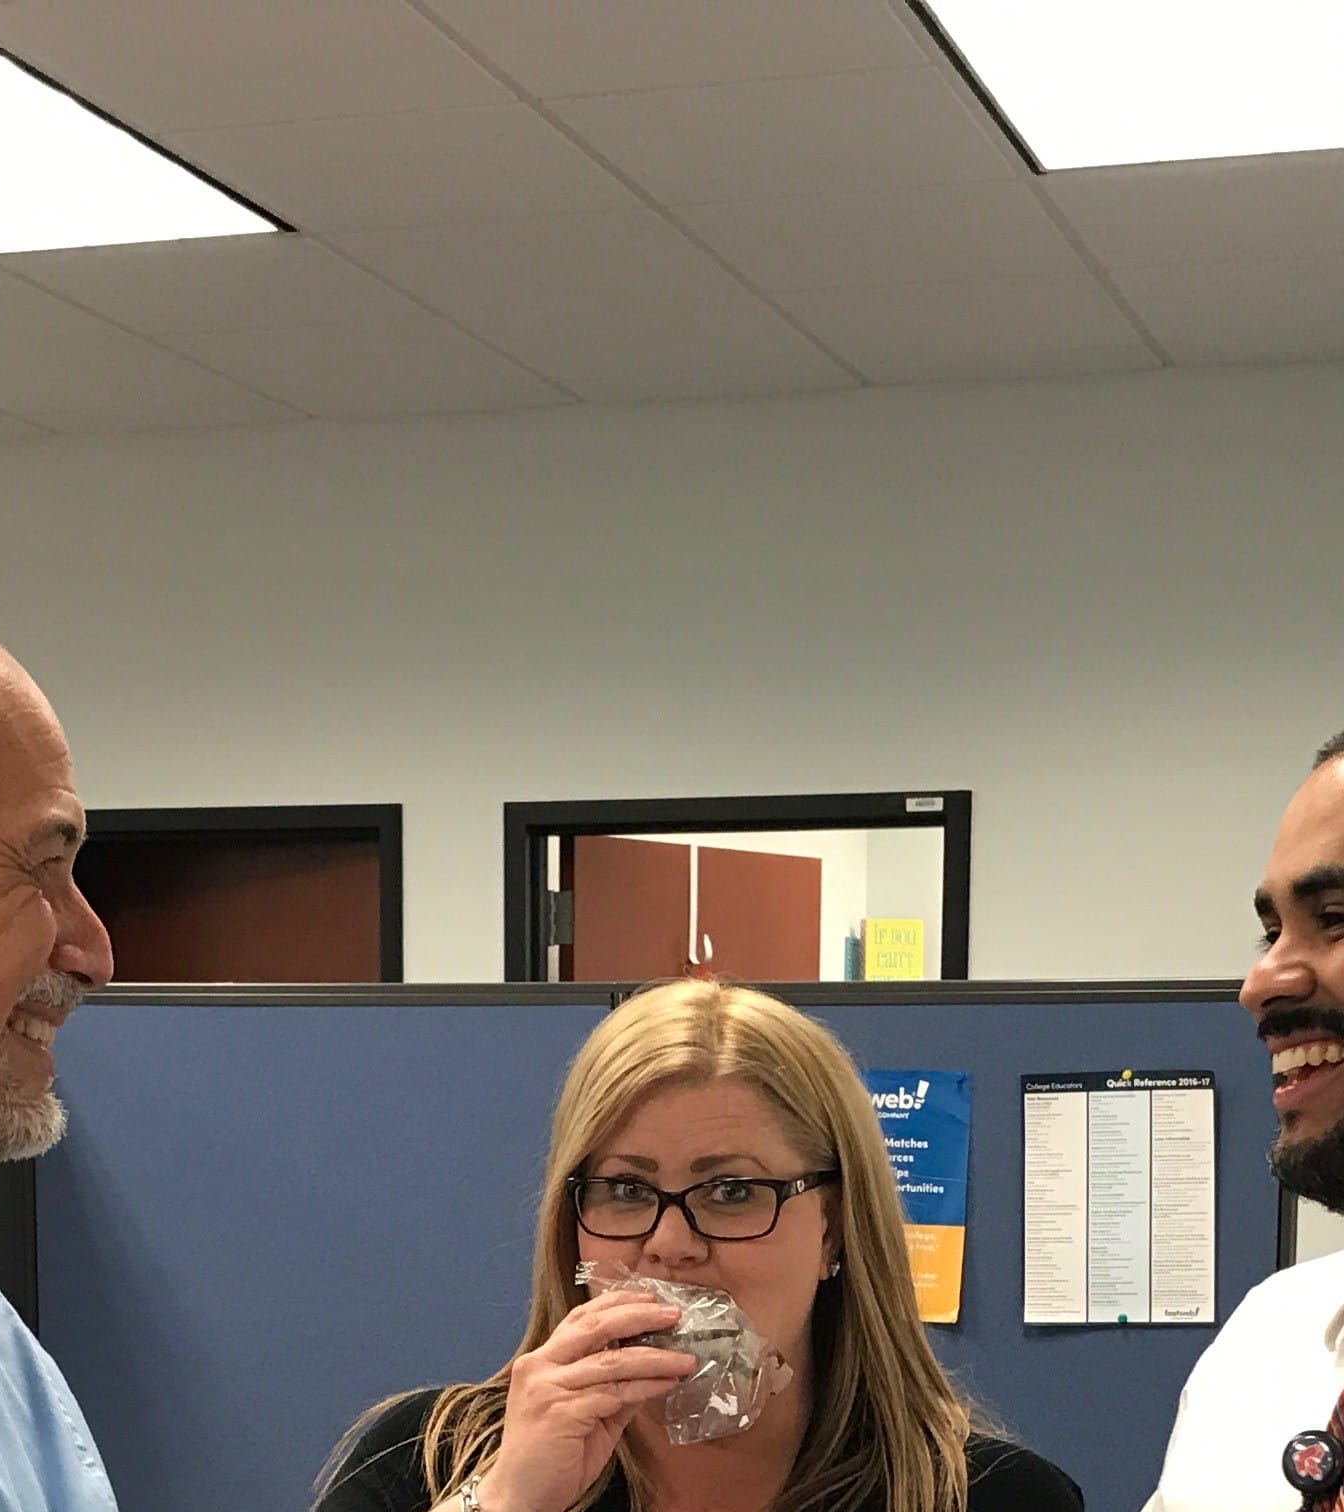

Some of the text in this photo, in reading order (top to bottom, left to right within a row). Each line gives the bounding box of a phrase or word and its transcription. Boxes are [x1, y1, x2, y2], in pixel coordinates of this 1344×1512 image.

[1026, 1077, 1210, 1091] College Educators Quick Reference 2016-17
[877, 1111, 910, 1119] COMPANY
[884, 1138, 929, 1149] Matches
